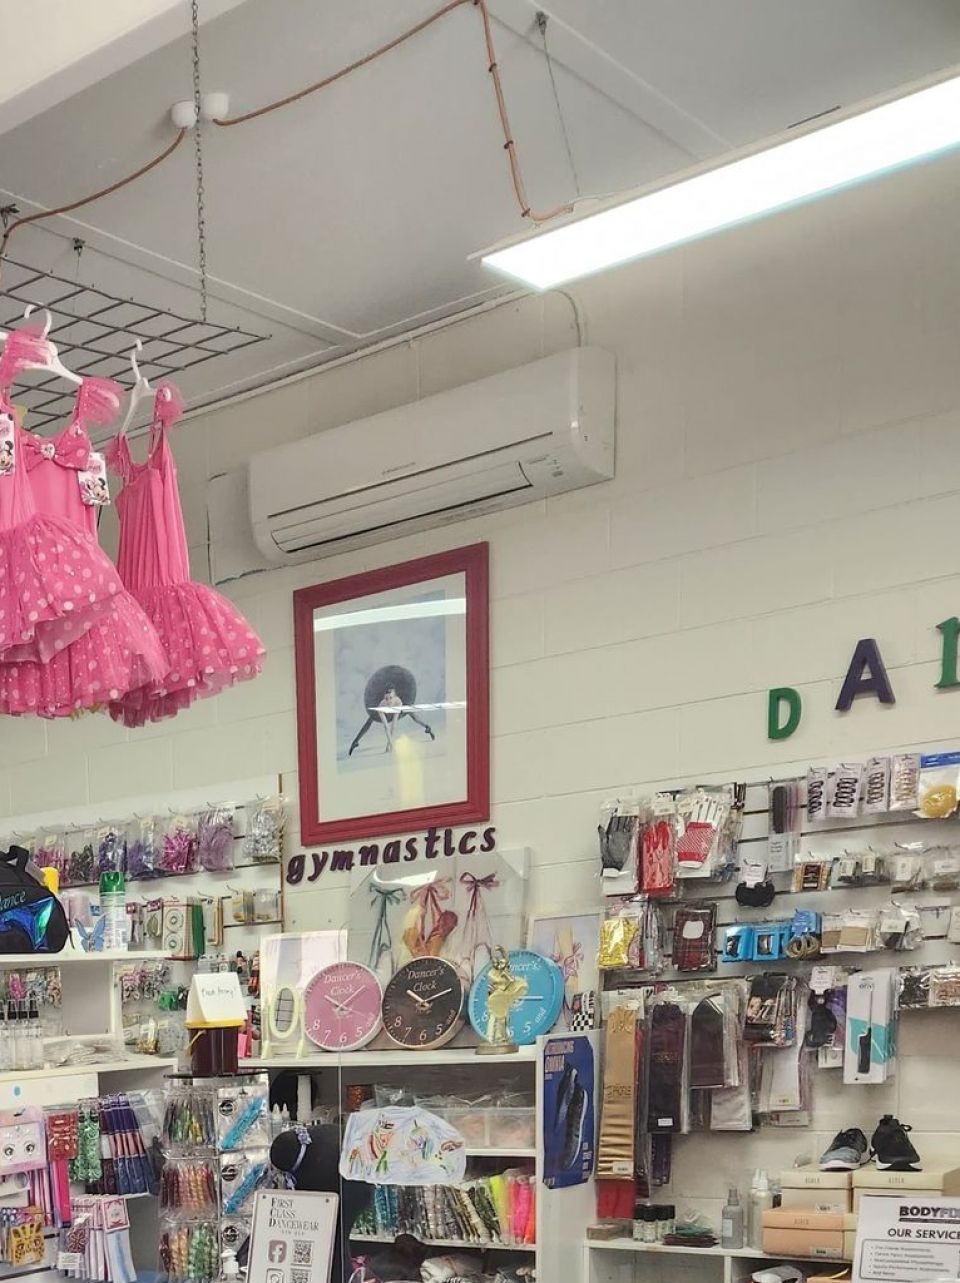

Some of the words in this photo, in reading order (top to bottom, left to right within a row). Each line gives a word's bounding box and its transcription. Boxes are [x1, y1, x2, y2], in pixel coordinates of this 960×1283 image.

[286, 826, 497, 885] gymnastics
[324, 969, 363, 984] Dancer's
[407, 965, 446, 980] Dancer's
[413, 981, 437, 992] Clock
[312, 1018, 321, 1031] 8
[394, 1015, 402, 1027] 8
[523, 1021, 532, 1033] 5
[355, 1026, 363, 1037] 5
[404, 1026, 412, 1039] 7
[435, 1023, 443, 1035] 5
[324, 1029, 332, 1042] 7
[339, 1032, 348, 1043] 6
[419, 1030, 427, 1041] 6
[271, 1197, 294, 1209] FIRST
[270, 1207, 296, 1219] CLASS
[268, 1218, 320, 1232] DANCEWEAR
[887, 1228, 912, 1238] OUR
